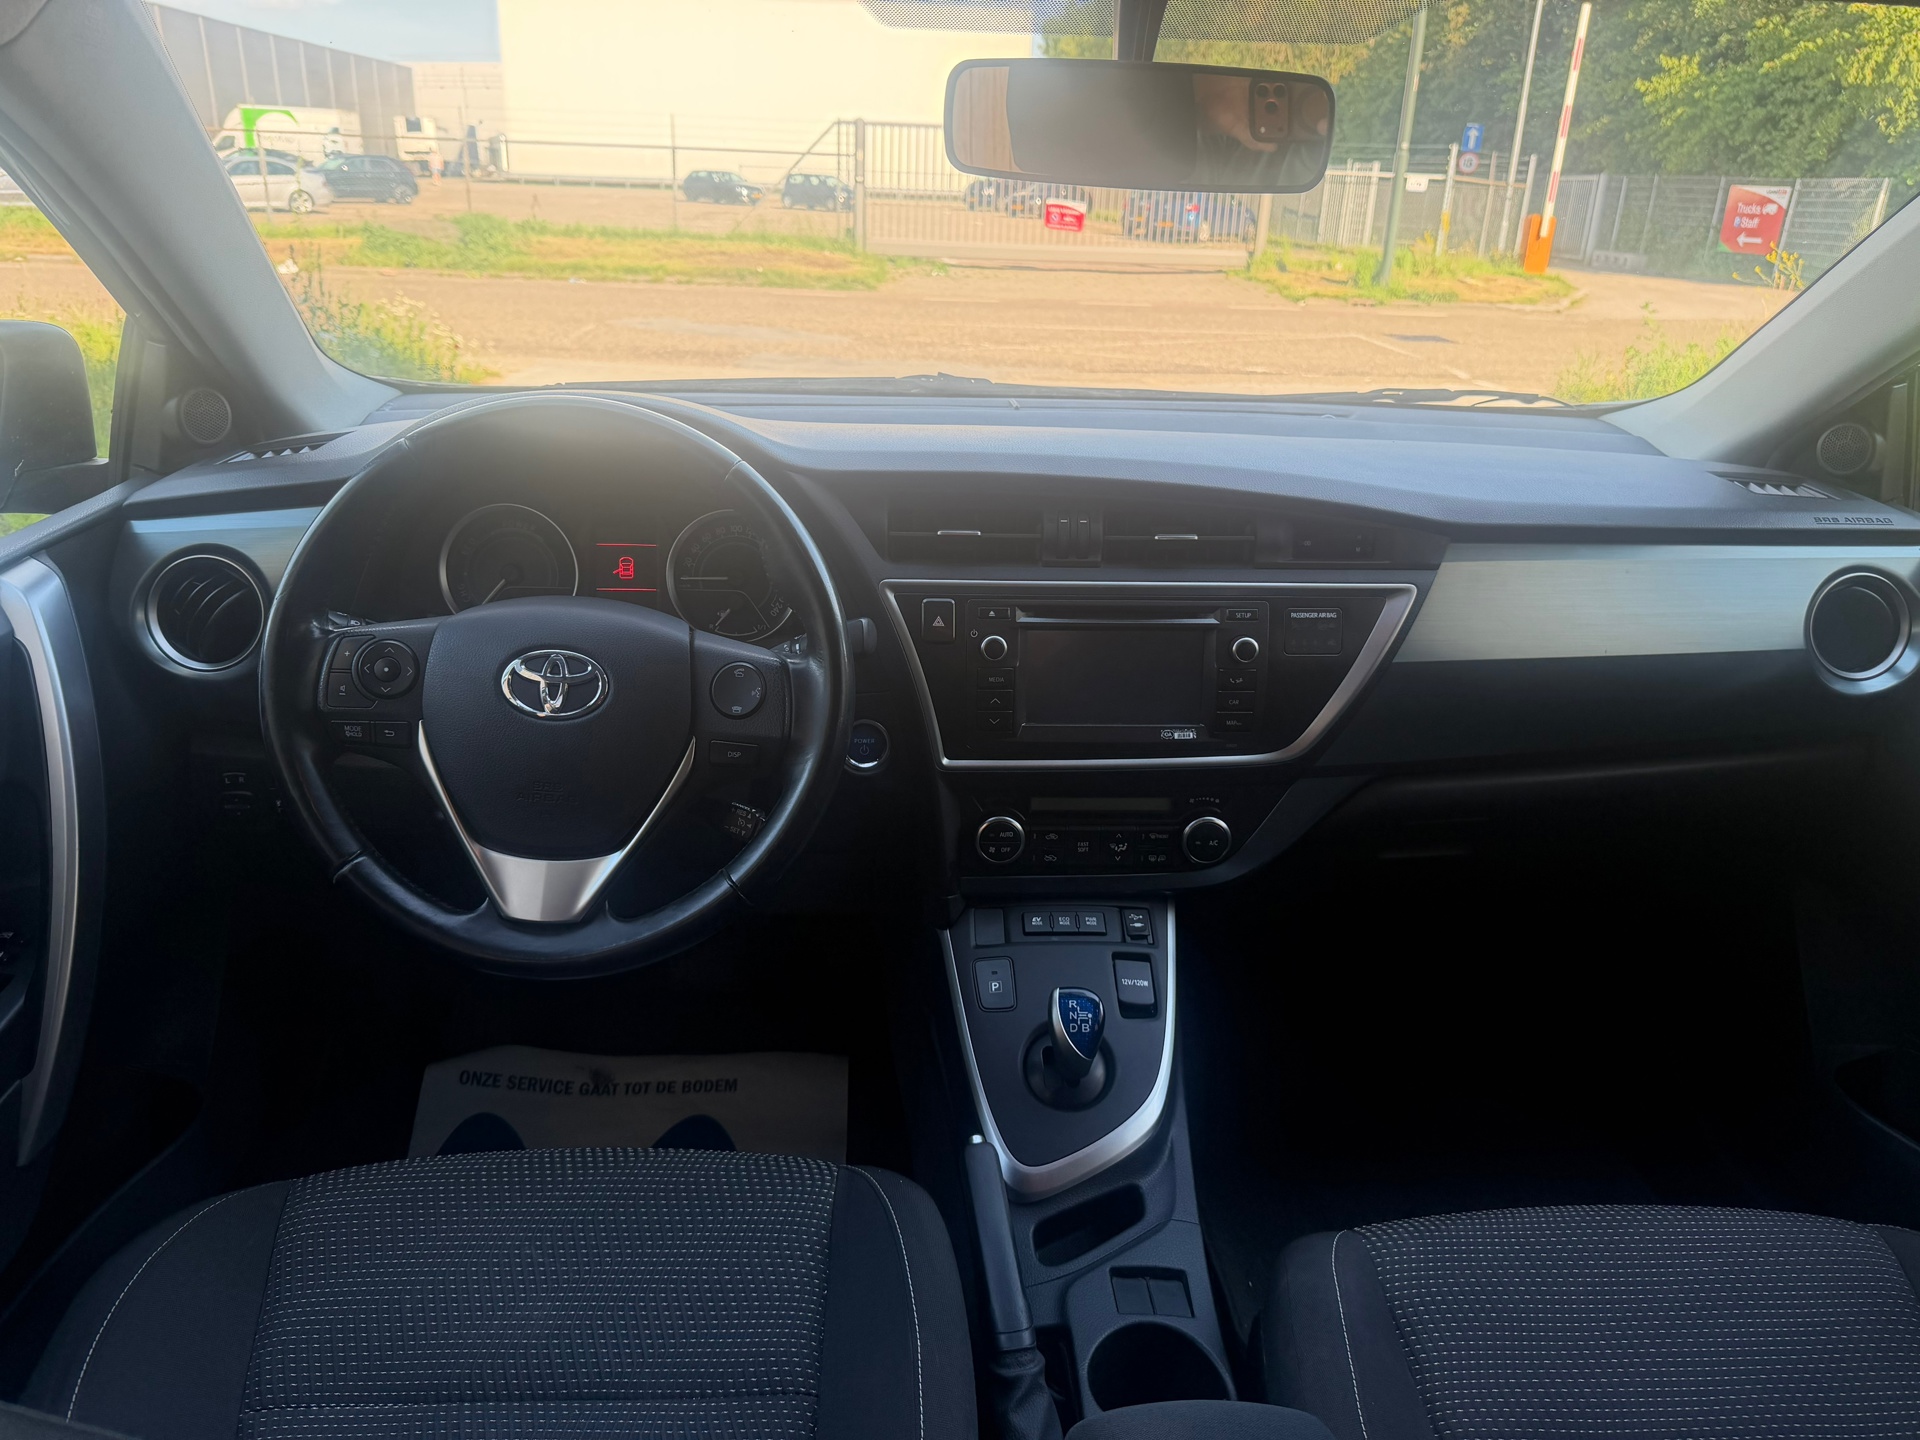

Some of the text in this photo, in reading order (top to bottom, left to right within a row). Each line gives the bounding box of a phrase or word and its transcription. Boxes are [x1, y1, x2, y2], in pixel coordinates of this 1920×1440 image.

[1737, 202, 1761, 215] Trucks
[1741, 216, 1760, 229] Staff
[727, 750, 742, 758] DISP
[735, 808, 747, 817] RES
[729, 826, 740, 834] SET
[1121, 978, 1149, 987] 12V/120W
[1068, 1000, 1077, 1009] R
[1069, 1011, 1077, 1020] N
[1069, 1023, 1090, 1032] D B
[459, 1070, 738, 1096] ONZE SERVICE GAAT TOT DE BODEM
